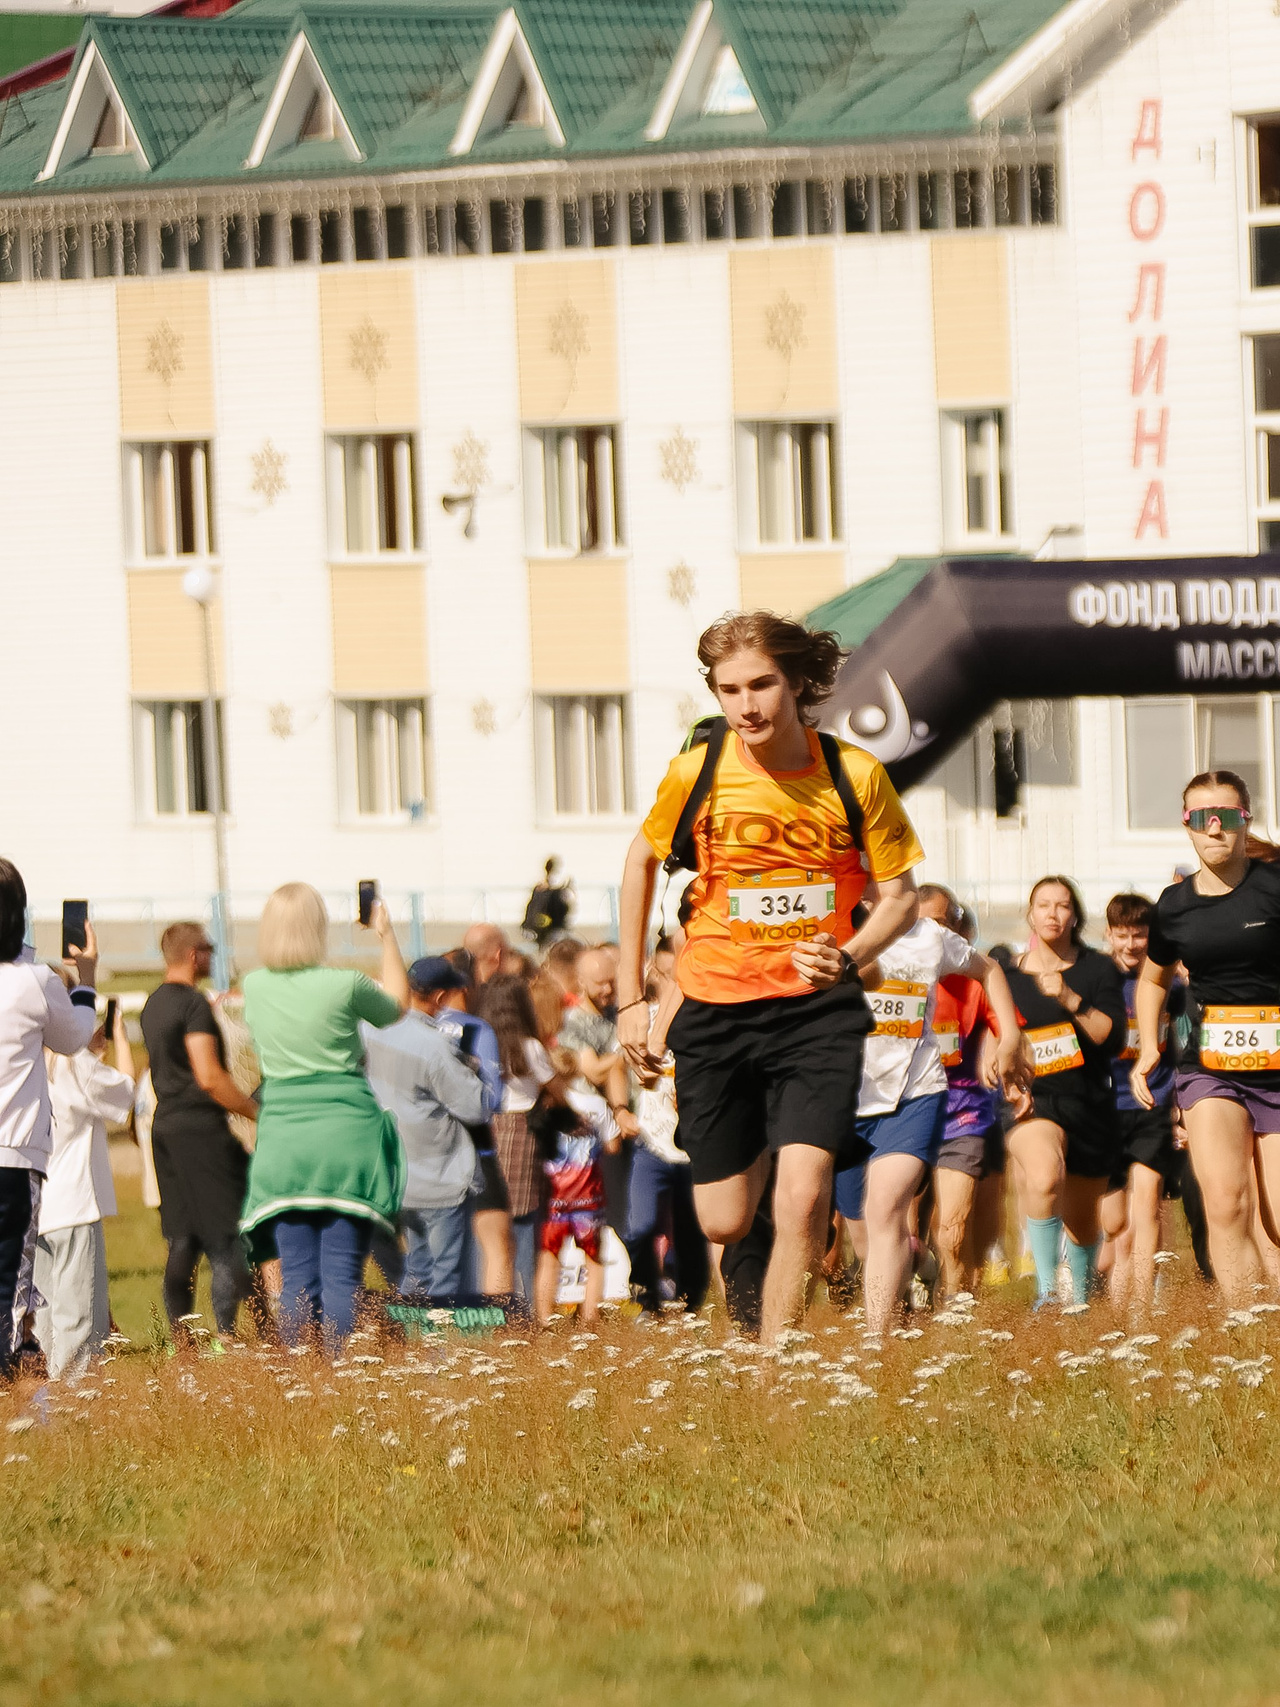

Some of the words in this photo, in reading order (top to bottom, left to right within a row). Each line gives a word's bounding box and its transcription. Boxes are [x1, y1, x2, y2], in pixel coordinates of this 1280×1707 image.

[1128, 98, 1169, 540] ДОЛИНА
[1070, 581, 1180, 631] ФОНД
[761, 894, 807, 917] 334
[750, 924, 819, 941] WOOD
[873, 999, 905, 1016] 288
[877, 1022, 910, 1034] OOD
[1224, 1030, 1259, 1047] 286
[1036, 1043, 1063, 1059] 264
[1216, 1056, 1270, 1068] WOOD
